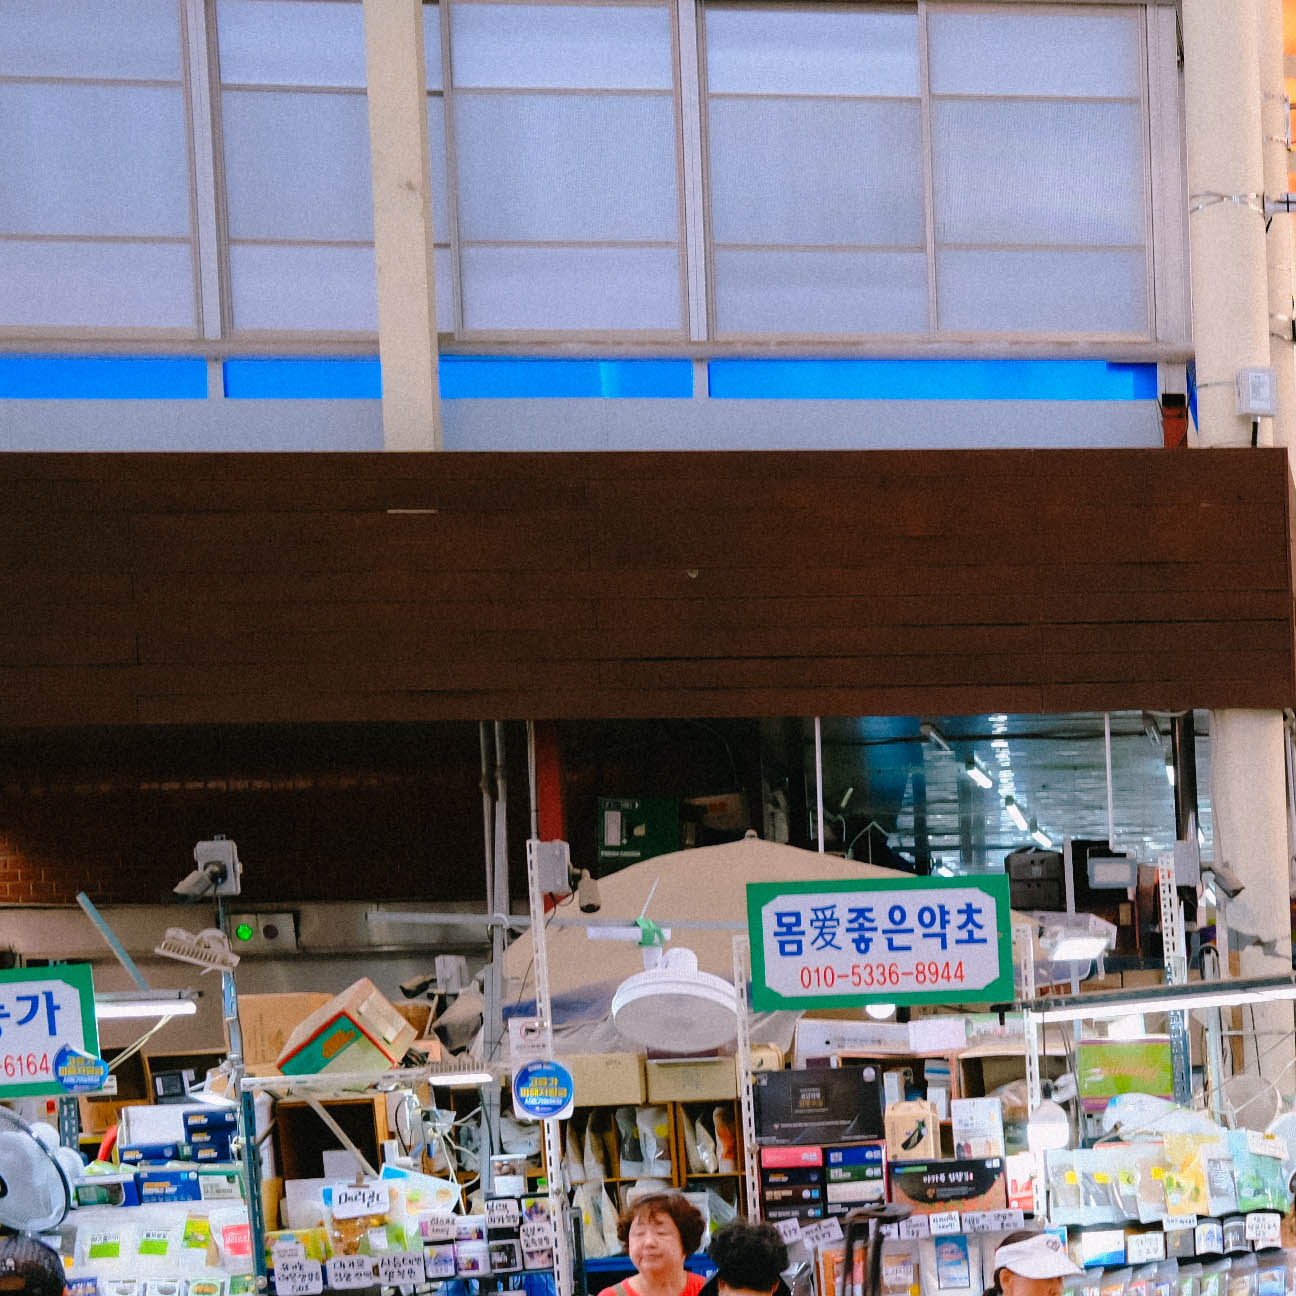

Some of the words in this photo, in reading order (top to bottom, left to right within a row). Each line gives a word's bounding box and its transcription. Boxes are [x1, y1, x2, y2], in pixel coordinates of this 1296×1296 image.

[773, 902, 988, 957] 몸爱좋은약초
[799, 960, 966, 990] 010-5336-8944
[0, 992, 61, 1036] 가
[0, 1052, 51, 1078] 6164
